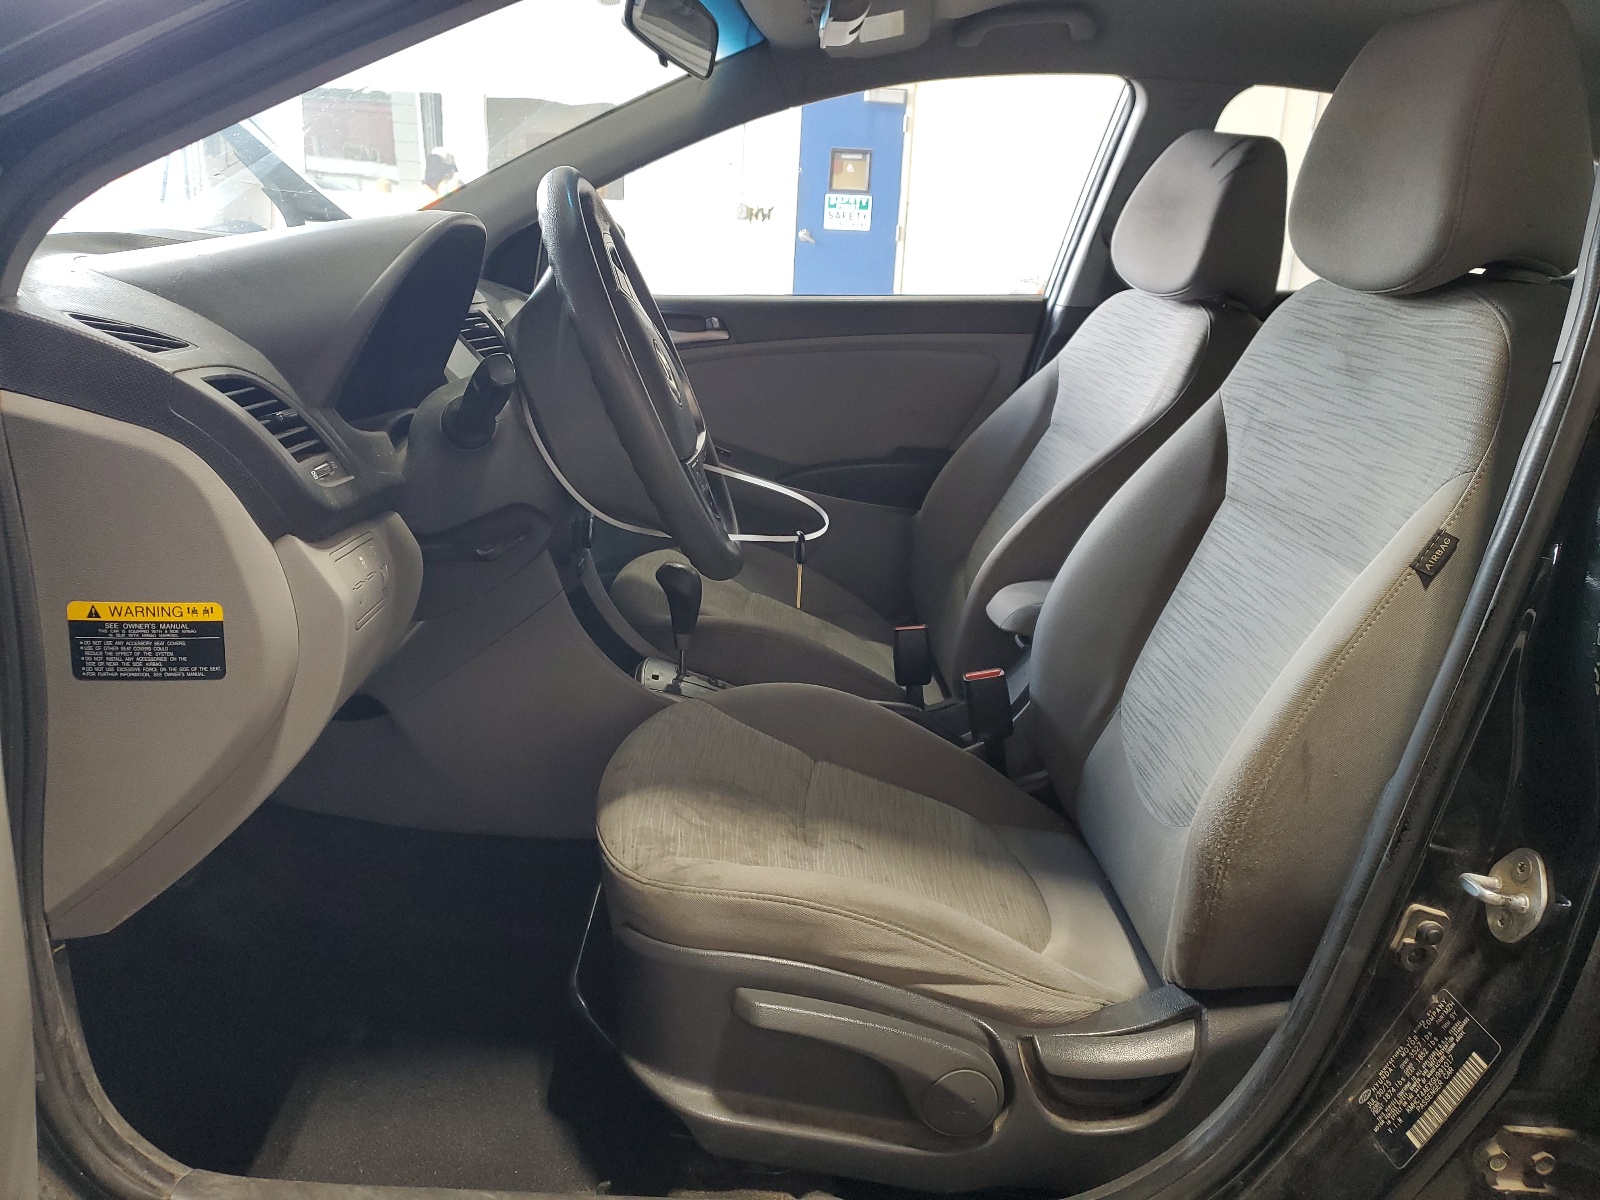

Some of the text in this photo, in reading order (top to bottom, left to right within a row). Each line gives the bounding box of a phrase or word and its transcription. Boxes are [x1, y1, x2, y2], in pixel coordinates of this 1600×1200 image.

[1425, 538, 1450, 570] AIRBAG
[108, 605, 183, 618] WARNING
[1442, 1000, 1456, 1015] MZH
[1370, 997, 1448, 1093] HYUNDAI MOTOR COMPANY
[1408, 1041, 1423, 1059] 3527
[1421, 1029, 1432, 1042] lbs
[1427, 1035, 1438, 1048] lbs
[1382, 1085, 1396, 1103] 1874
[1394, 1074, 1406, 1088] lbs
[1404, 1052, 1455, 1114] KMHCT4AEXGU991017
[1415, 1065, 1455, 1113] PASSENGER CAR
